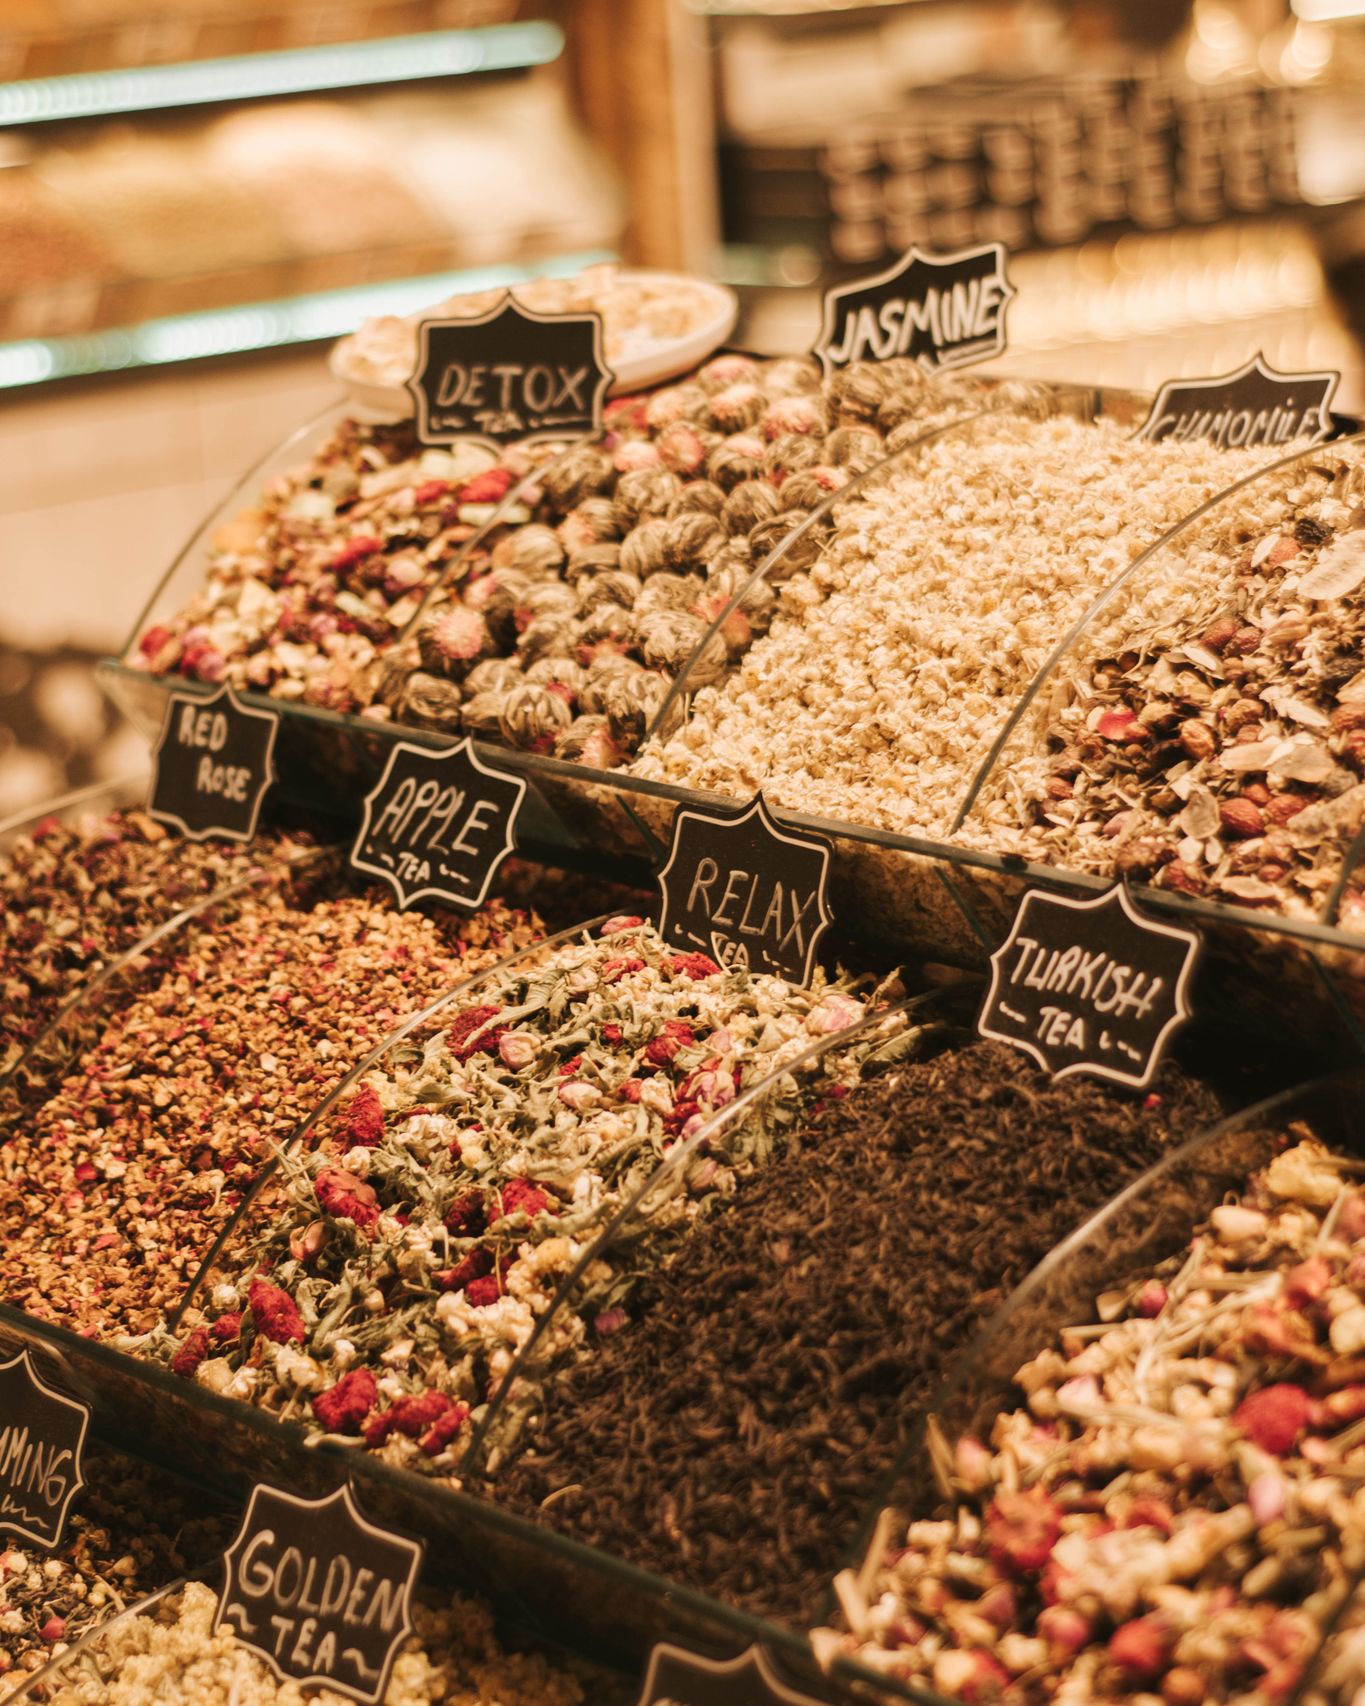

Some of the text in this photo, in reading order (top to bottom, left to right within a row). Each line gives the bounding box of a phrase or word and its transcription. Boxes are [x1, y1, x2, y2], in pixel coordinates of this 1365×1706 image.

[827, 273, 1001, 363] JASMINE
[436, 364, 588, 412] DETOX
[178, 704, 228, 752] RED
[372, 777, 499, 856] APPLE
[396, 852, 431, 883] TEA
[687, 857, 817, 959] RELAX
[1010, 936, 1163, 1020] TURKISH
[1036, 1006, 1085, 1051] TEA
[238, 1529, 406, 1632] GOLDEN
[270, 1614, 336, 1674] TEA
